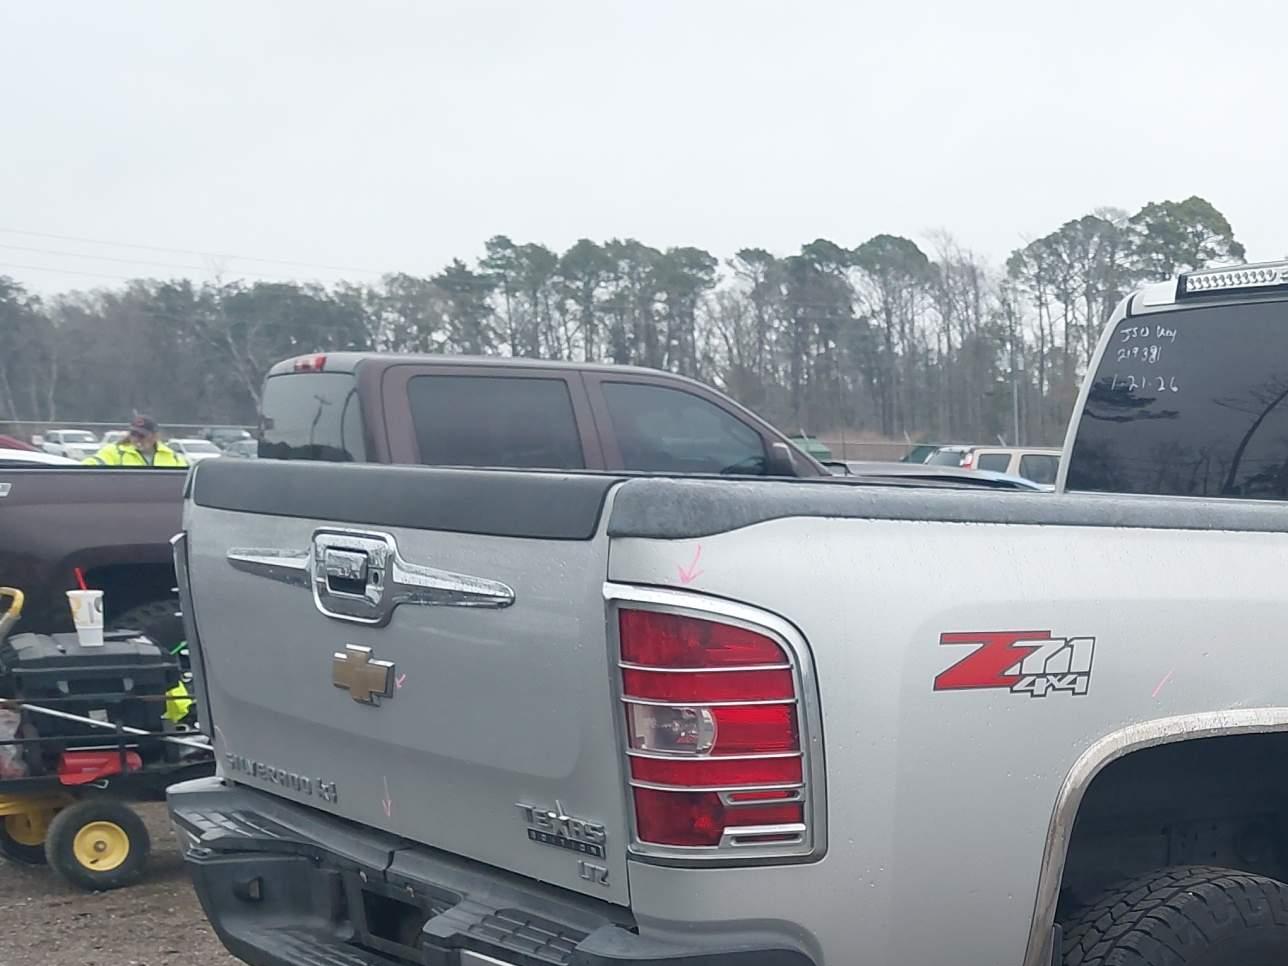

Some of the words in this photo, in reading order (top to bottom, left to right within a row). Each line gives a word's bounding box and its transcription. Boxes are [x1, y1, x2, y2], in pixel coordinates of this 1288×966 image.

[932, 629, 1097, 692] Z71
[225, 751, 313, 796] SILVERADO
[514, 800, 607, 844] TEXAS
